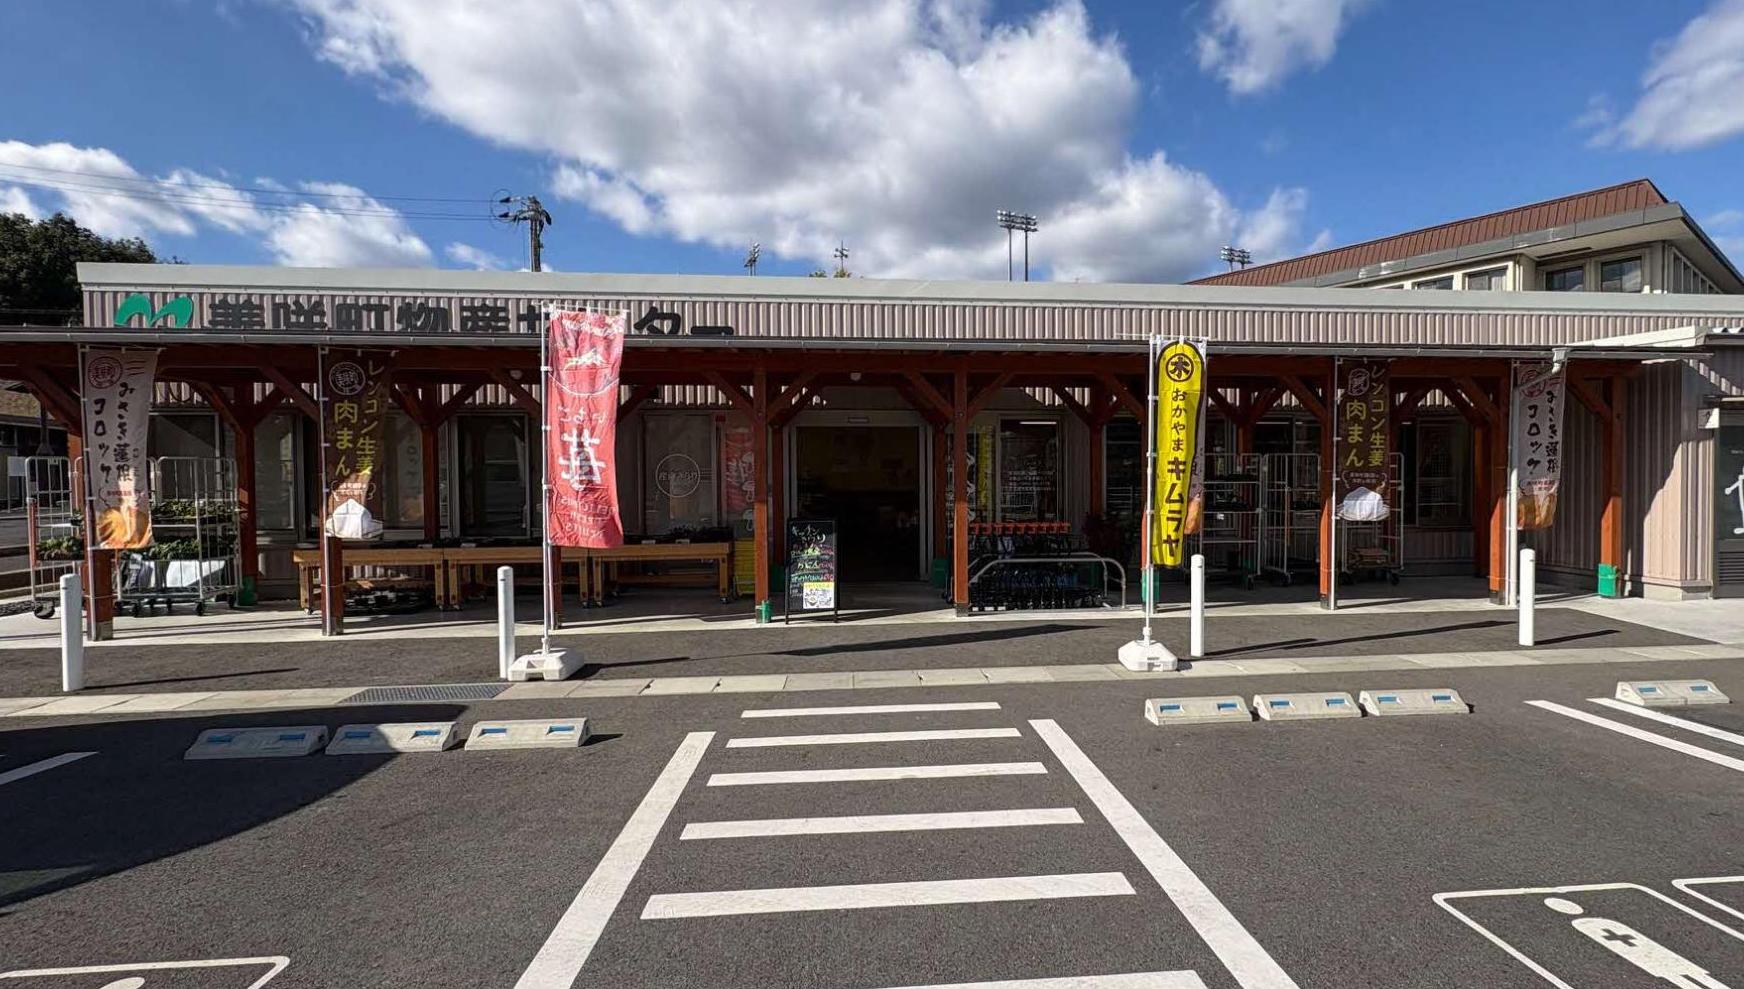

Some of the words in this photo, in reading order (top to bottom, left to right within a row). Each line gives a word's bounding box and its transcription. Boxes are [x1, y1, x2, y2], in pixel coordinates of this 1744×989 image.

[94, 398, 112, 484] コロッケ
[335, 400, 358, 477] 肉まん
[356, 360, 384, 475] レンコン生姜
[1171, 388, 1187, 452] おかやま
[1345, 400, 1366, 467] 肉まん
[1368, 366, 1386, 466] レンコン生姜
[1527, 404, 1542, 475] コロッケ
[1162, 457, 1187, 557] キムラヤ
